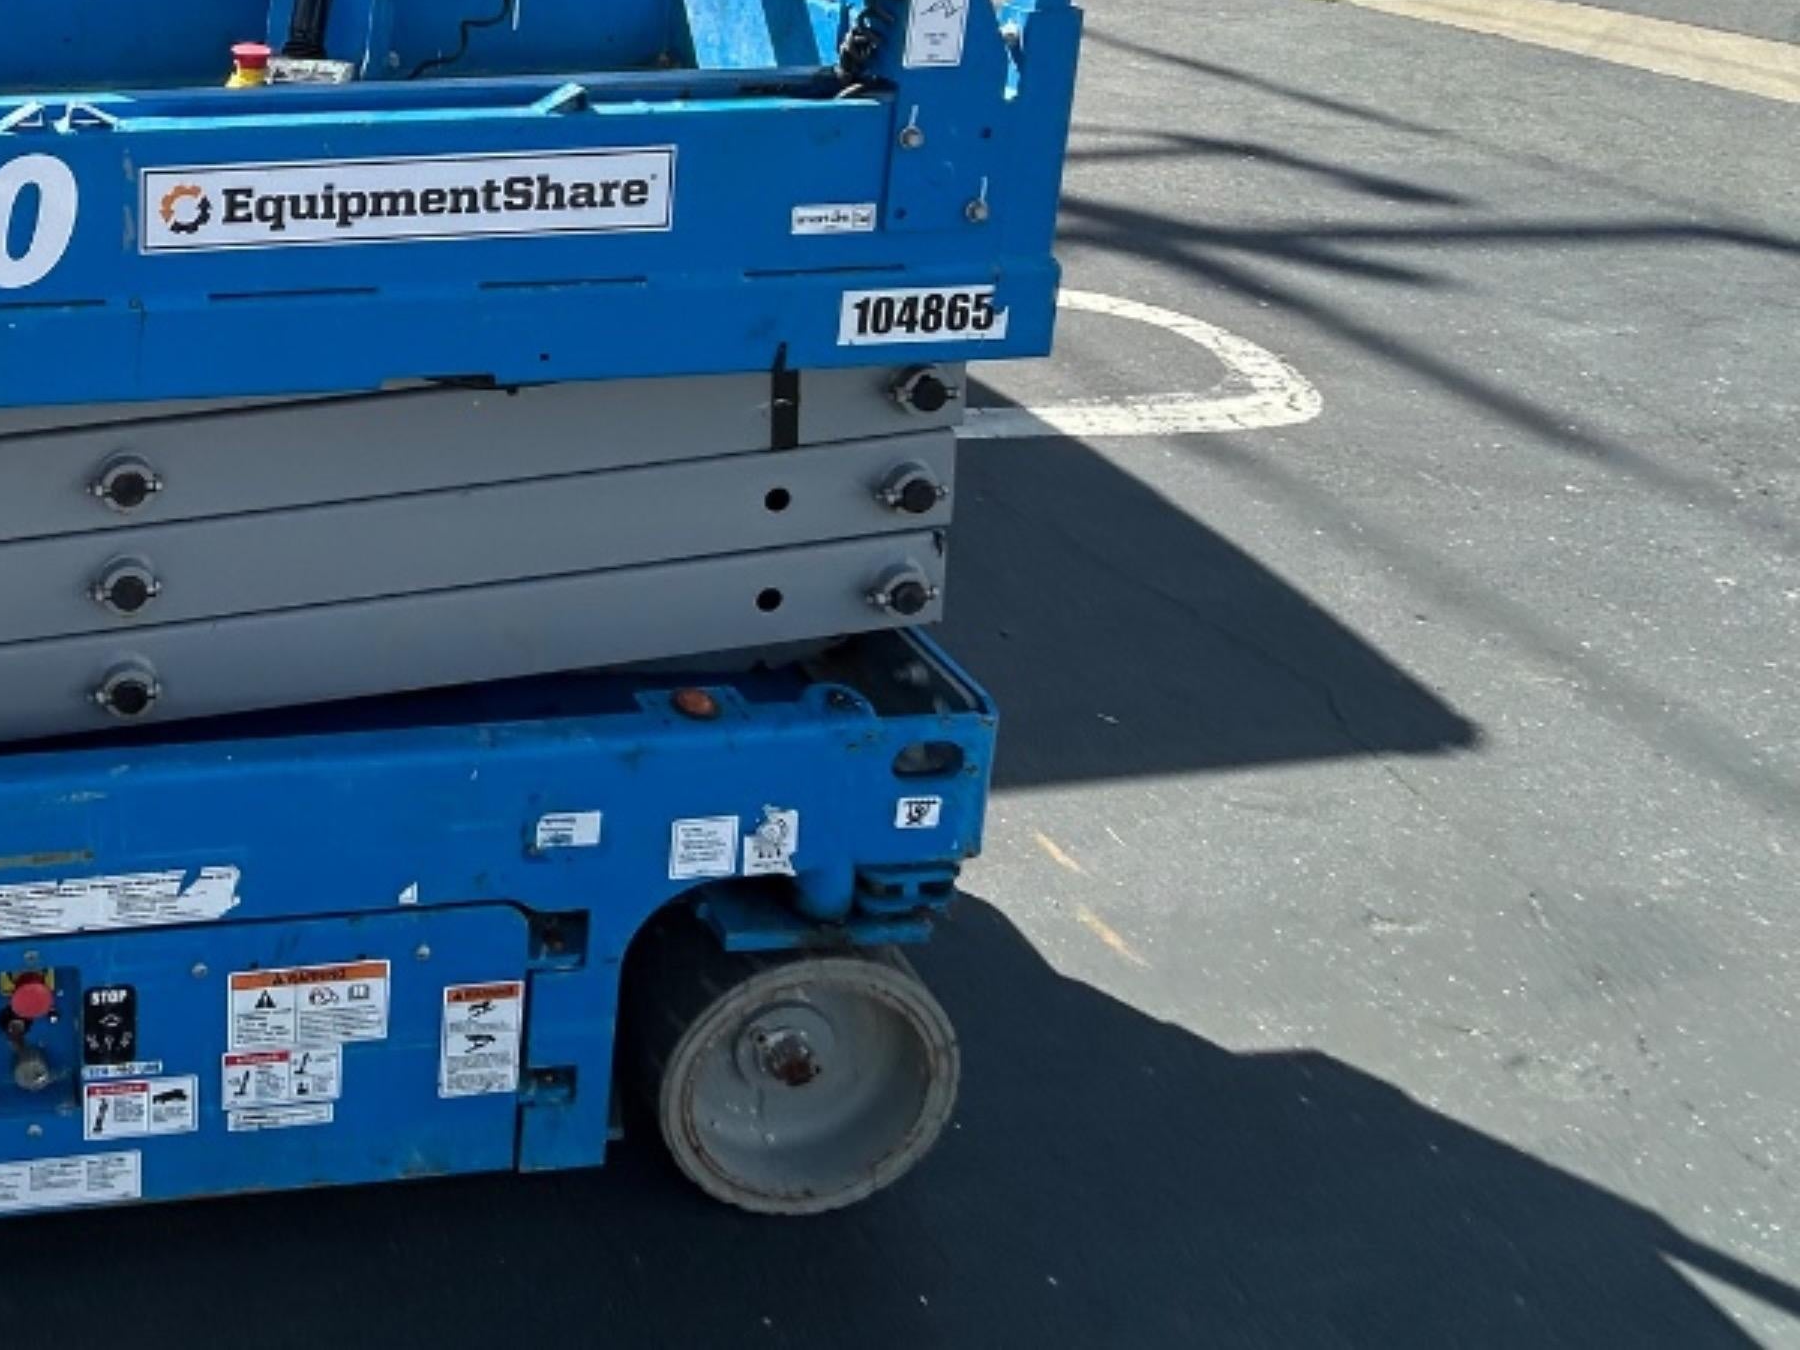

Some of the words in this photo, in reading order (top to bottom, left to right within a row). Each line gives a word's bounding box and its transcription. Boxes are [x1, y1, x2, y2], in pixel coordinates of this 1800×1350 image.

[221, 173, 651, 231] EquipmentShare
[853, 293, 995, 336] 104865
[91, 989, 128, 1005] STOP
